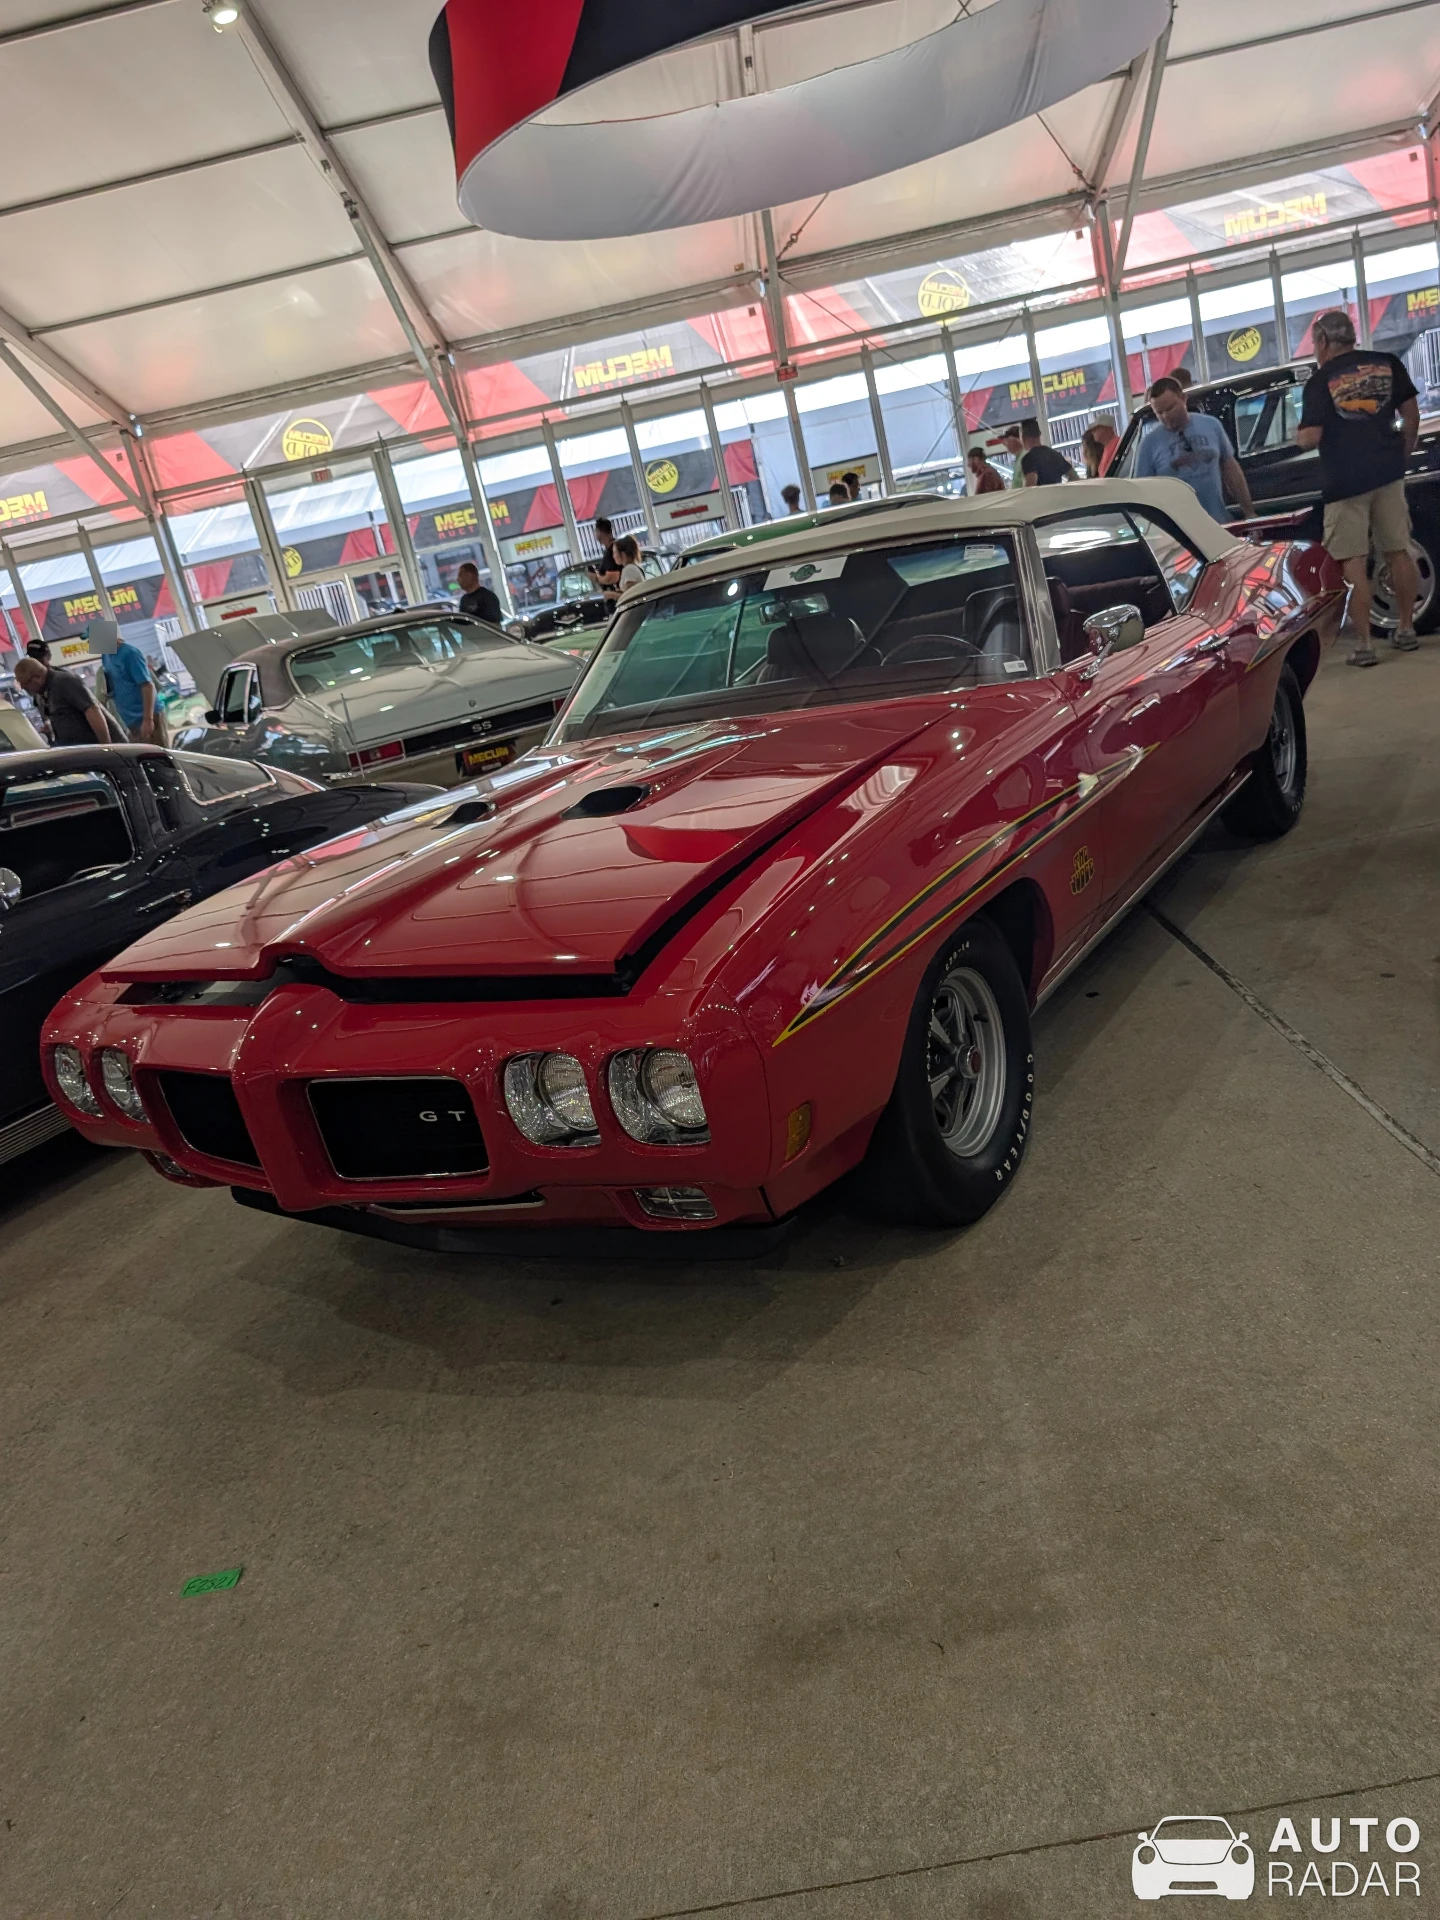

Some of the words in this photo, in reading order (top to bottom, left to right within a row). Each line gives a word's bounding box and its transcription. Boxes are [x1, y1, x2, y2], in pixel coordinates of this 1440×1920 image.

[1231, 336, 1260, 356] SOLD
[651, 469, 677, 488] SOLD
[433, 501, 509, 532] MECM
[471, 720, 493, 733] SS
[468, 747, 509, 765] MECUM
[995, 1053, 1034, 1181] GOODYEAR
